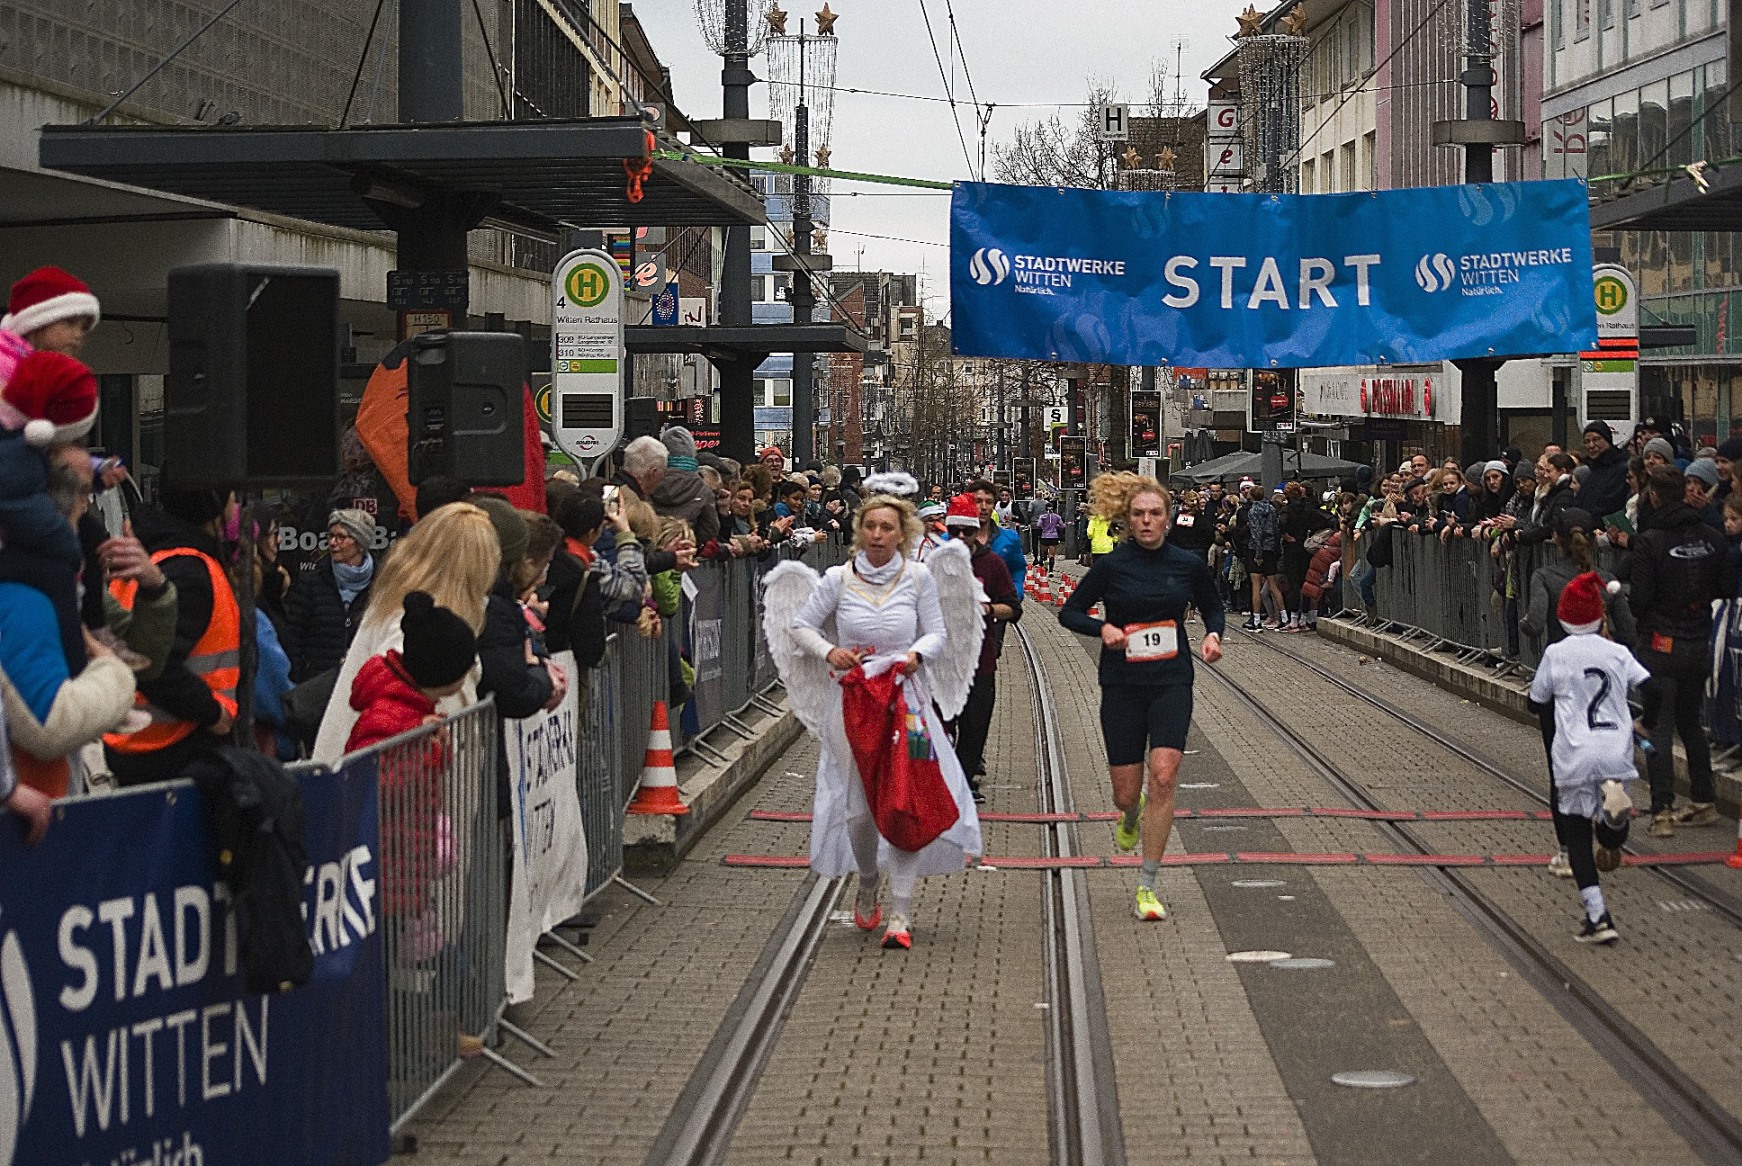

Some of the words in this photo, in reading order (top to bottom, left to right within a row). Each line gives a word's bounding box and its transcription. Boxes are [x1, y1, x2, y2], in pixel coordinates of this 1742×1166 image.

[1014, 255, 1126, 275] STADTWERKE
[1460, 248, 1573, 270] STADTWERKE
[1014, 270, 1072, 287] WITTEN
[1162, 254, 1381, 310] START
[1460, 269, 1520, 286] WITTEN
[556, 296, 567, 309] 4
[556, 316, 583, 324] Witten
[584, 316, 618, 324] Rathaus
[559, 349, 575, 357] 310
[1143, 632, 1161, 647] 19
[1584, 667, 1619, 731] 2
[57, 845, 377, 1013] STADTRKE
[60, 994, 270, 1139] WITTEN
